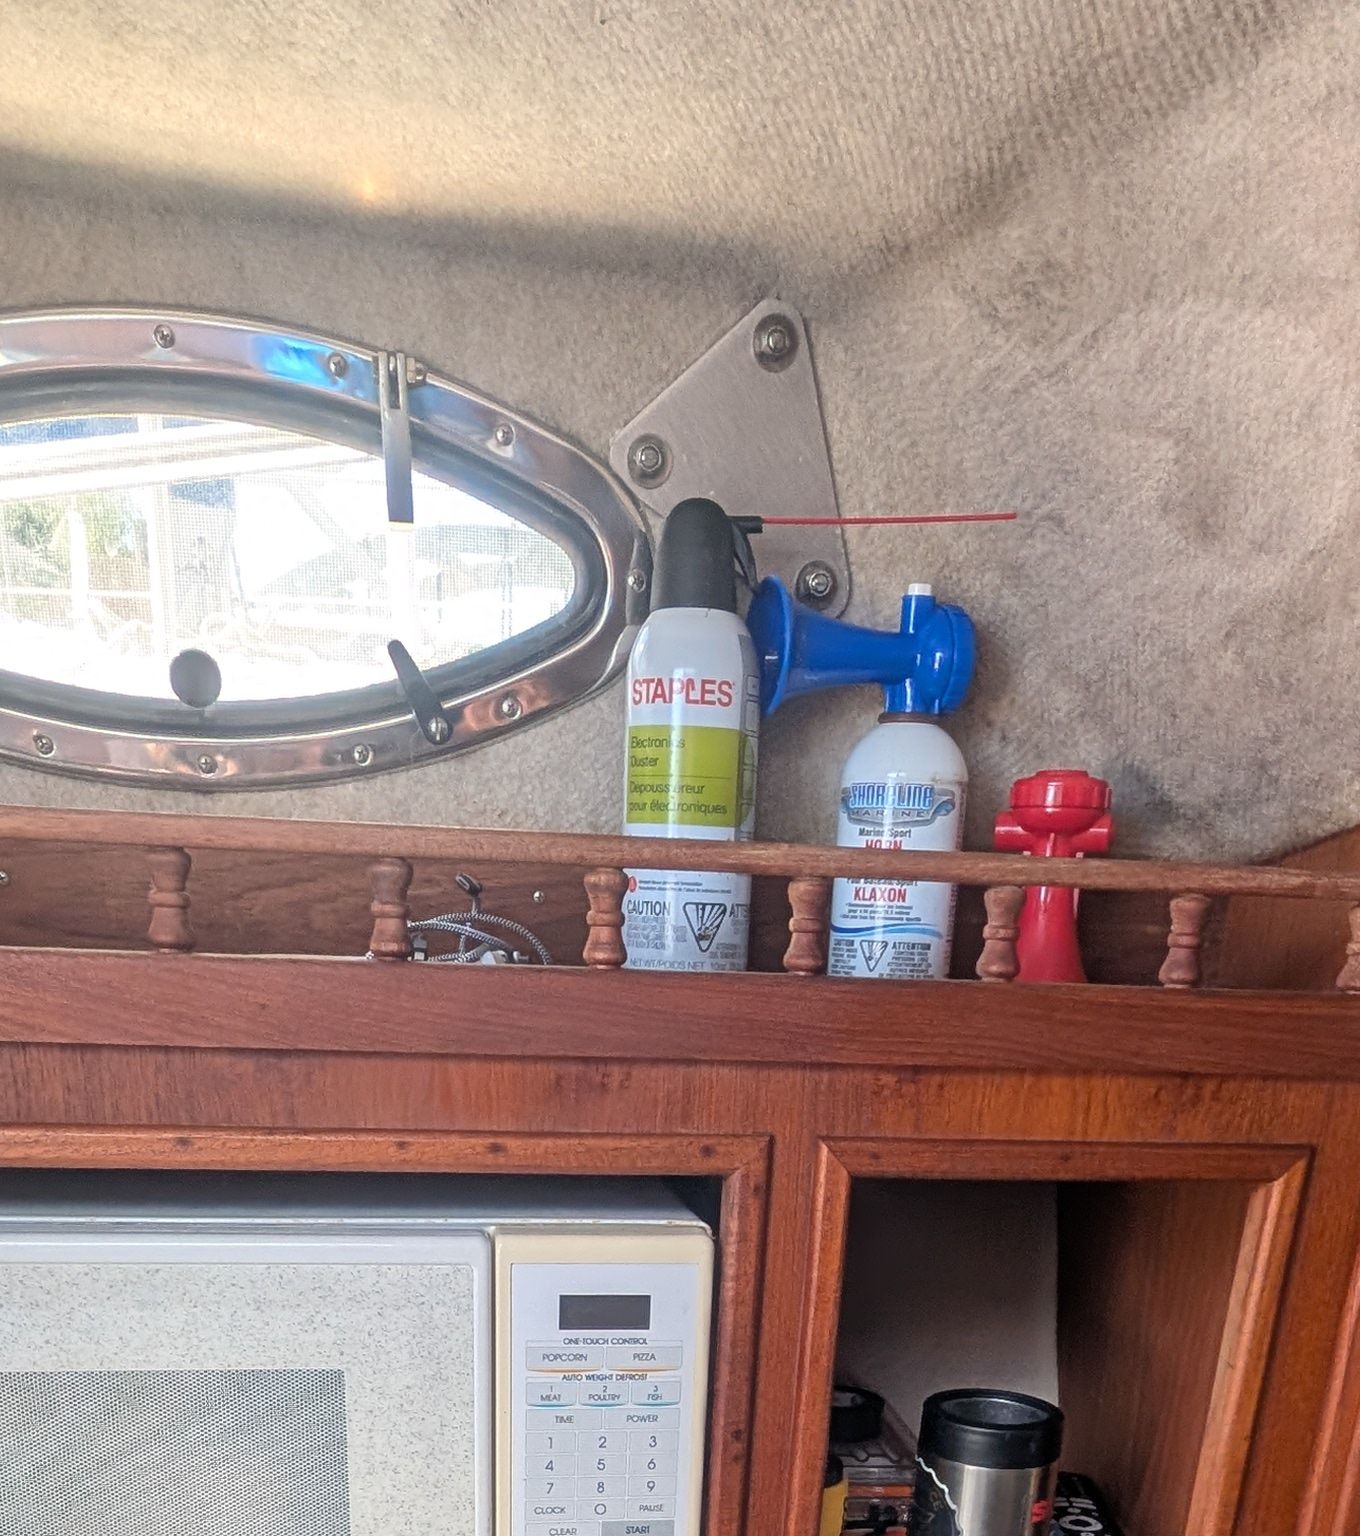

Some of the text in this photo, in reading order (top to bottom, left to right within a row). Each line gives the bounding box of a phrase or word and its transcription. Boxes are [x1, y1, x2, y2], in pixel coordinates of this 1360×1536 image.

[632, 676, 733, 708] STAPLES
[630, 736, 686, 749] Electronis
[629, 756, 660, 768] Duster
[851, 810, 925, 818] MARINE
[888, 828, 912, 838] Sport
[853, 886, 907, 903] KLAXON
[626, 899, 671, 917] CAUTION
[610, 1337, 648, 1345] CONTROL
[542, 1353, 588, 1362] POPCORN
[632, 1353, 657, 1361] PIZZA
[585, 1374, 614, 1382] WEIGHT
[615, 1373, 648, 1381] DEFROST
[555, 1415, 575, 1423] TIME
[548, 1437, 553, 1449] 1
[598, 1436, 607, 1448] 2
[649, 1435, 657, 1448] 3
[545, 1460, 554, 1471] 4
[596, 1459, 606, 1471] 5
[647, 1458, 656, 1470] 6
[546, 1482, 554, 1494] 7
[596, 1481, 605, 1493] 8
[647, 1480, 656, 1492] 9
[534, 1506, 566, 1515] CLOCK
[639, 1504, 663, 1512] PAUSE
[549, 1527, 577, 1536] CLEAR
[625, 1525, 650, 1534] START
